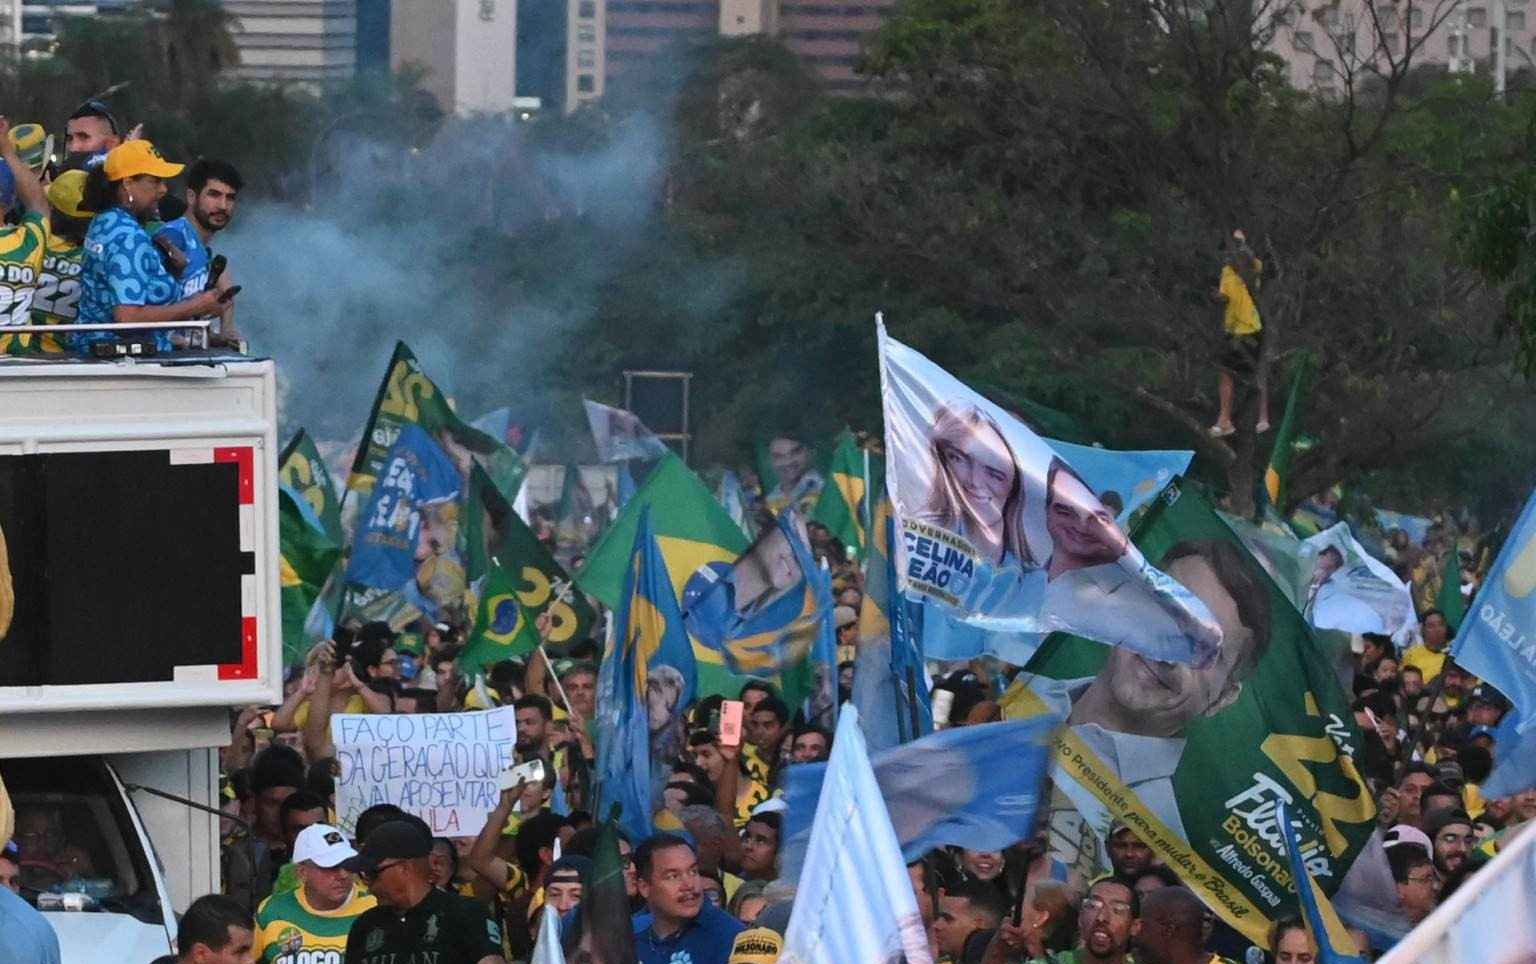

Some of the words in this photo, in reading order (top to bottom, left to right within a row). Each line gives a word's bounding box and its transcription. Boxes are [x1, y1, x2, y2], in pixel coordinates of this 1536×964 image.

[7, 264, 34, 284] DO
[904, 531, 975, 579] CELINA
[908, 557, 952, 589] EÃO
[341, 717, 414, 748] FAÇO
[421, 709, 512, 743] PARTE
[338, 748, 367, 787] DA
[370, 739, 468, 784] GERAÇÃO
[472, 742, 513, 779] QUE
[400, 779, 498, 809] APOSENTAR
[1123, 803, 1158, 842] para
[1202, 875, 1250, 919] Brasil
